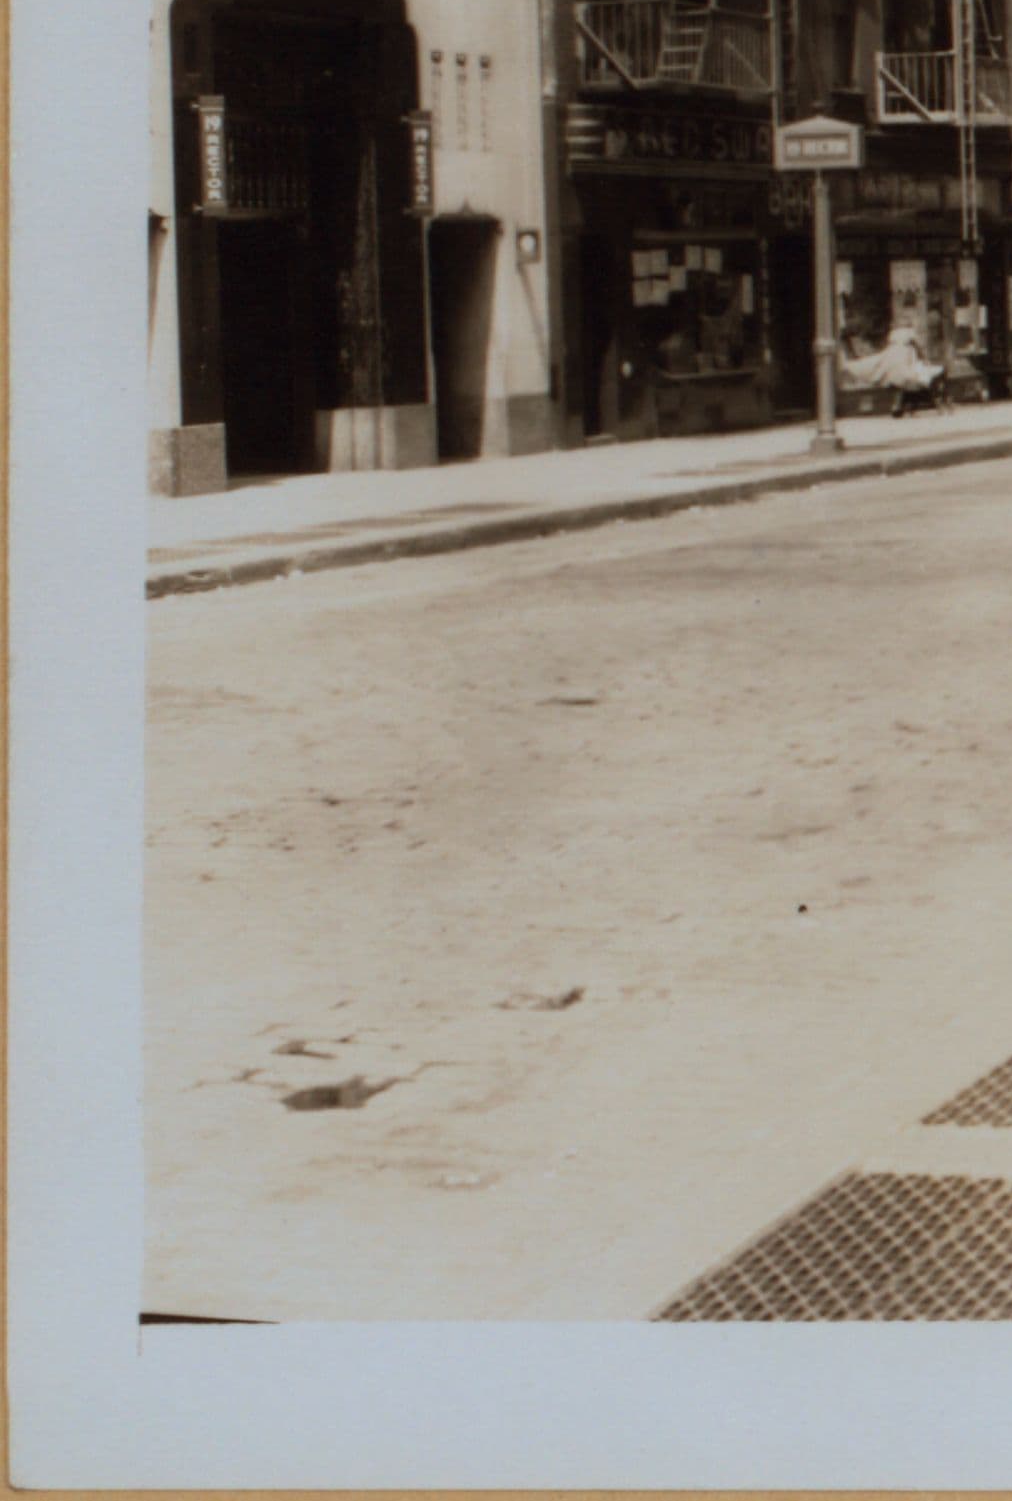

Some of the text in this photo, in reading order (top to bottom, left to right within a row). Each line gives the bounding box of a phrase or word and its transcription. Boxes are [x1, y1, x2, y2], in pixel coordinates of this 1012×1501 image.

[205, 133, 223, 200] RECTOR
[711, 121, 773, 160] SWA
[414, 144, 429, 204] RECTOR
